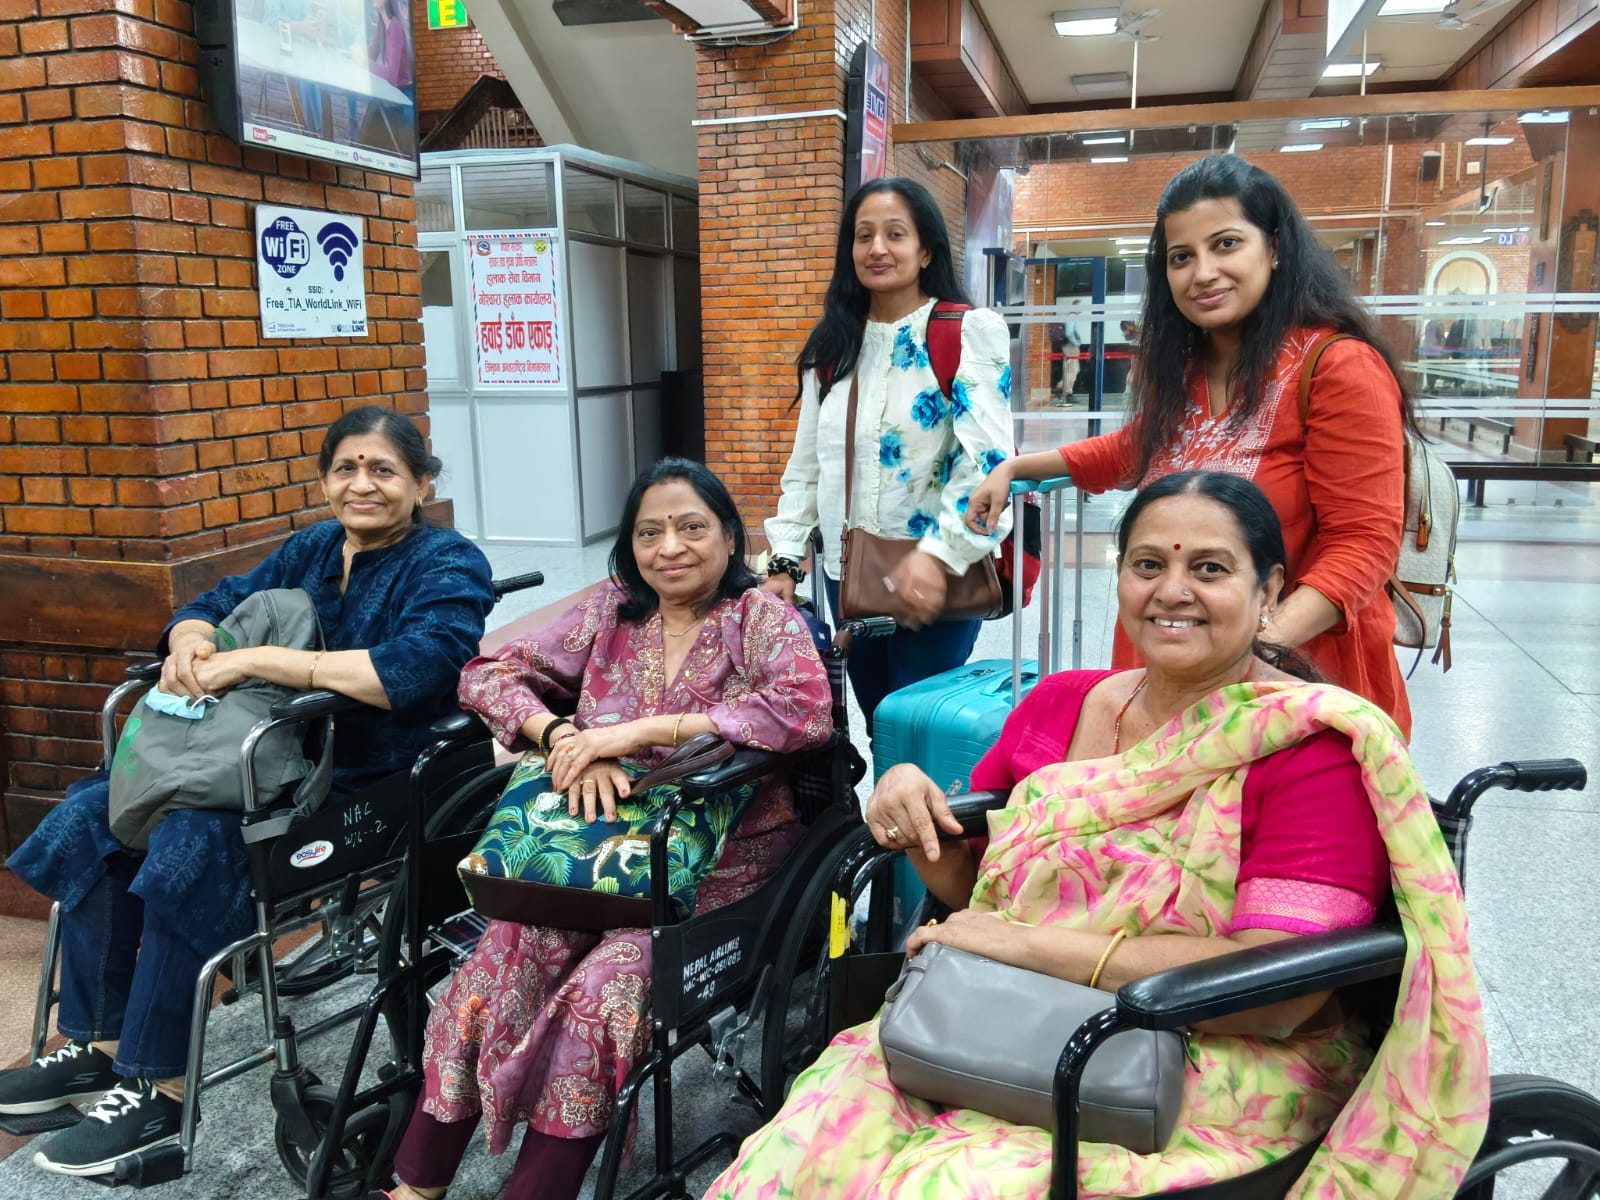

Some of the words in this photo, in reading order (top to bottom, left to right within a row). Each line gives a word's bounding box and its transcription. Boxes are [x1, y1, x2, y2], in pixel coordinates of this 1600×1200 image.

[275, 220, 295, 231] FREE
[277, 265, 297, 274] ZONE
[480, 312, 503, 356] हवाई
[683, 954, 708, 980] NEPAL
[709, 936, 740, 964] AIRLINES
